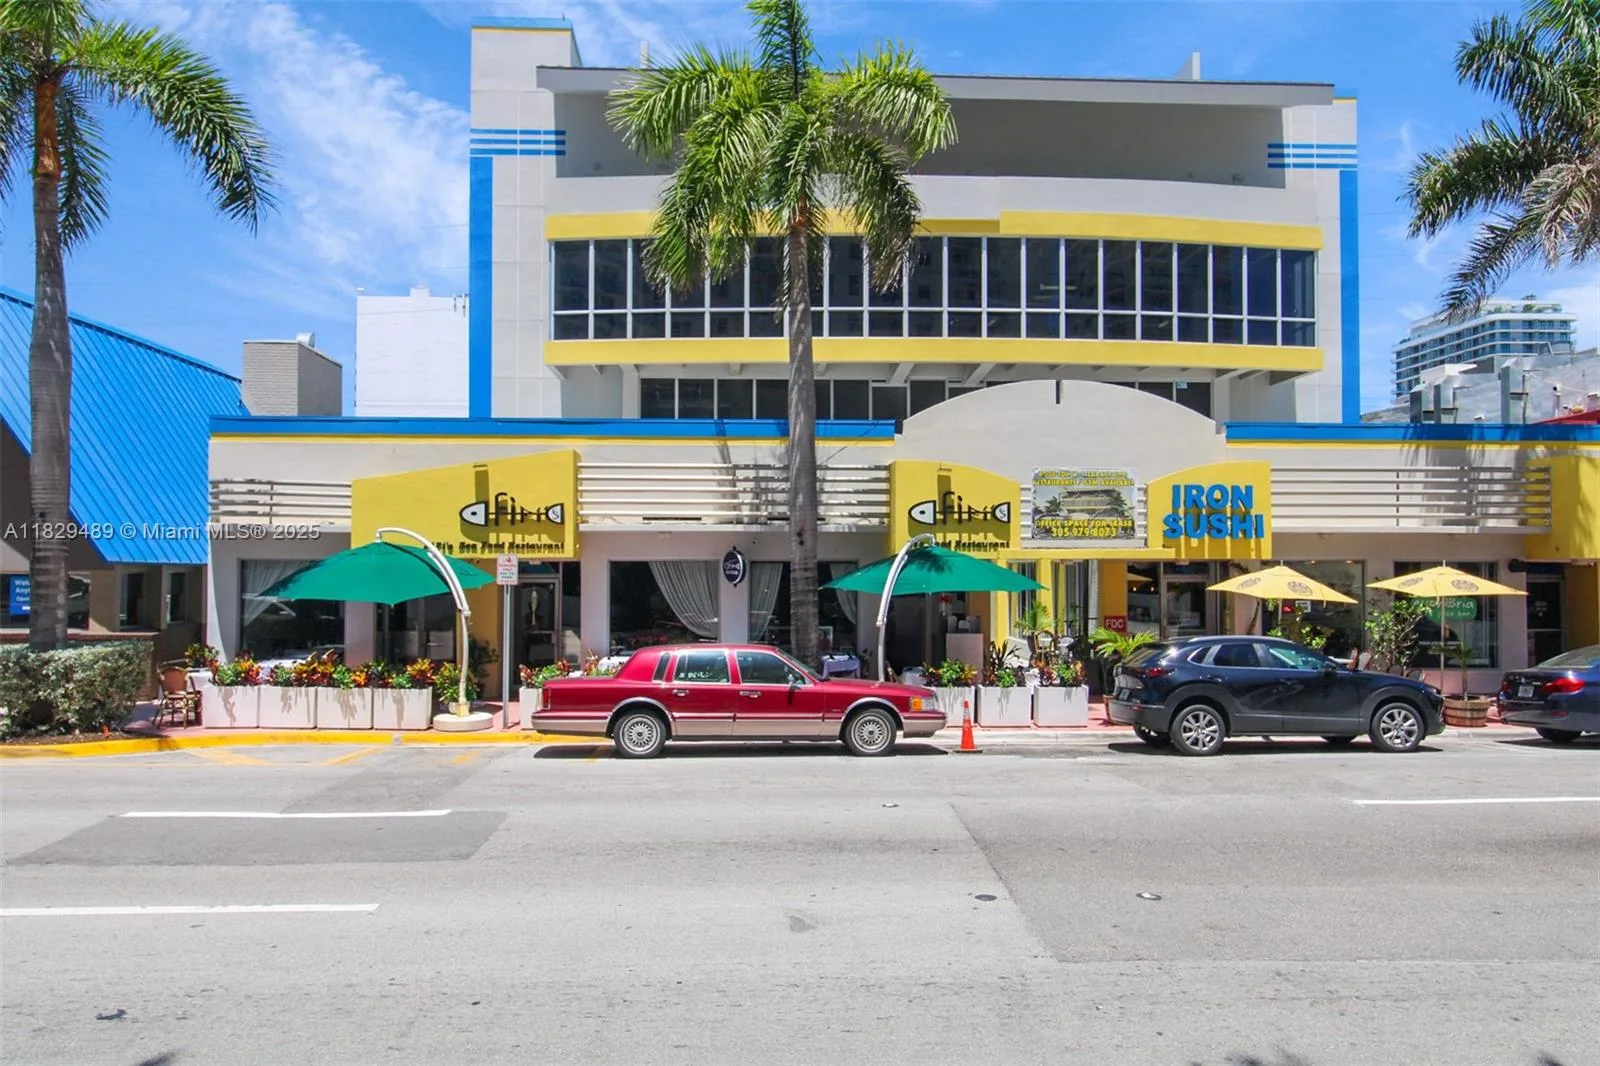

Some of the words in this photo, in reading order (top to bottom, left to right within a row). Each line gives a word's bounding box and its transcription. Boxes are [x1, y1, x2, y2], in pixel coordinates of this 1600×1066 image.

[1172, 484, 1253, 510] IRON
[1163, 513, 1264, 539] SUSHI
[508, 541, 564, 550] Restaurant
[955, 540, 1010, 549] Restaurant
[1105, 618, 1125, 629] FDC
